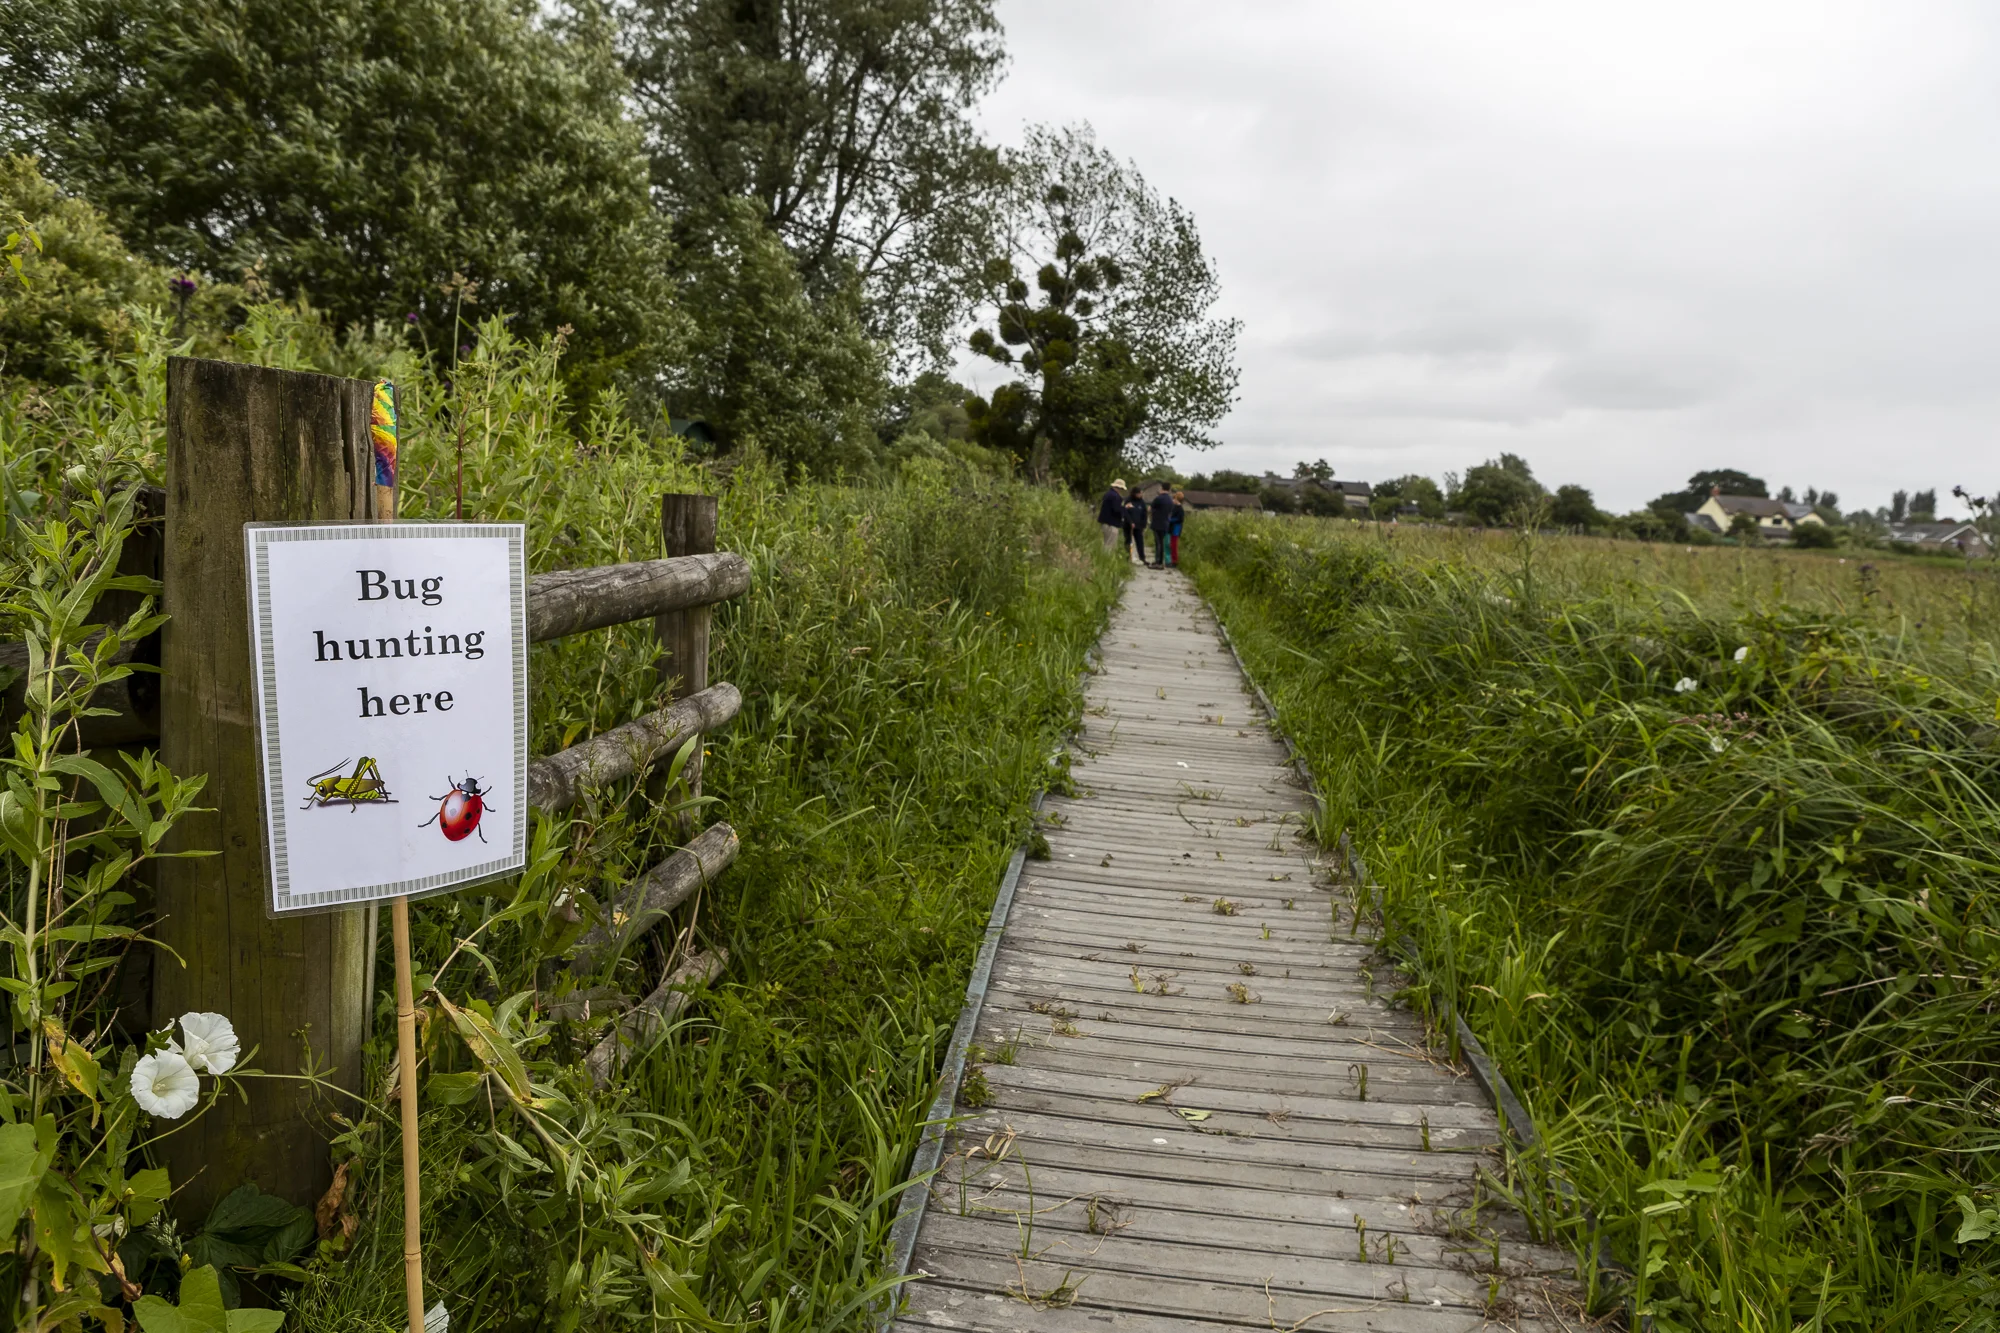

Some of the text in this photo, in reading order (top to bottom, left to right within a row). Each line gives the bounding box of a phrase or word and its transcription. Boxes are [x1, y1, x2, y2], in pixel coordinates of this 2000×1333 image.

[356, 570, 443, 605] Bug
[313, 626, 484, 660] hunting
[357, 687, 453, 717] here
